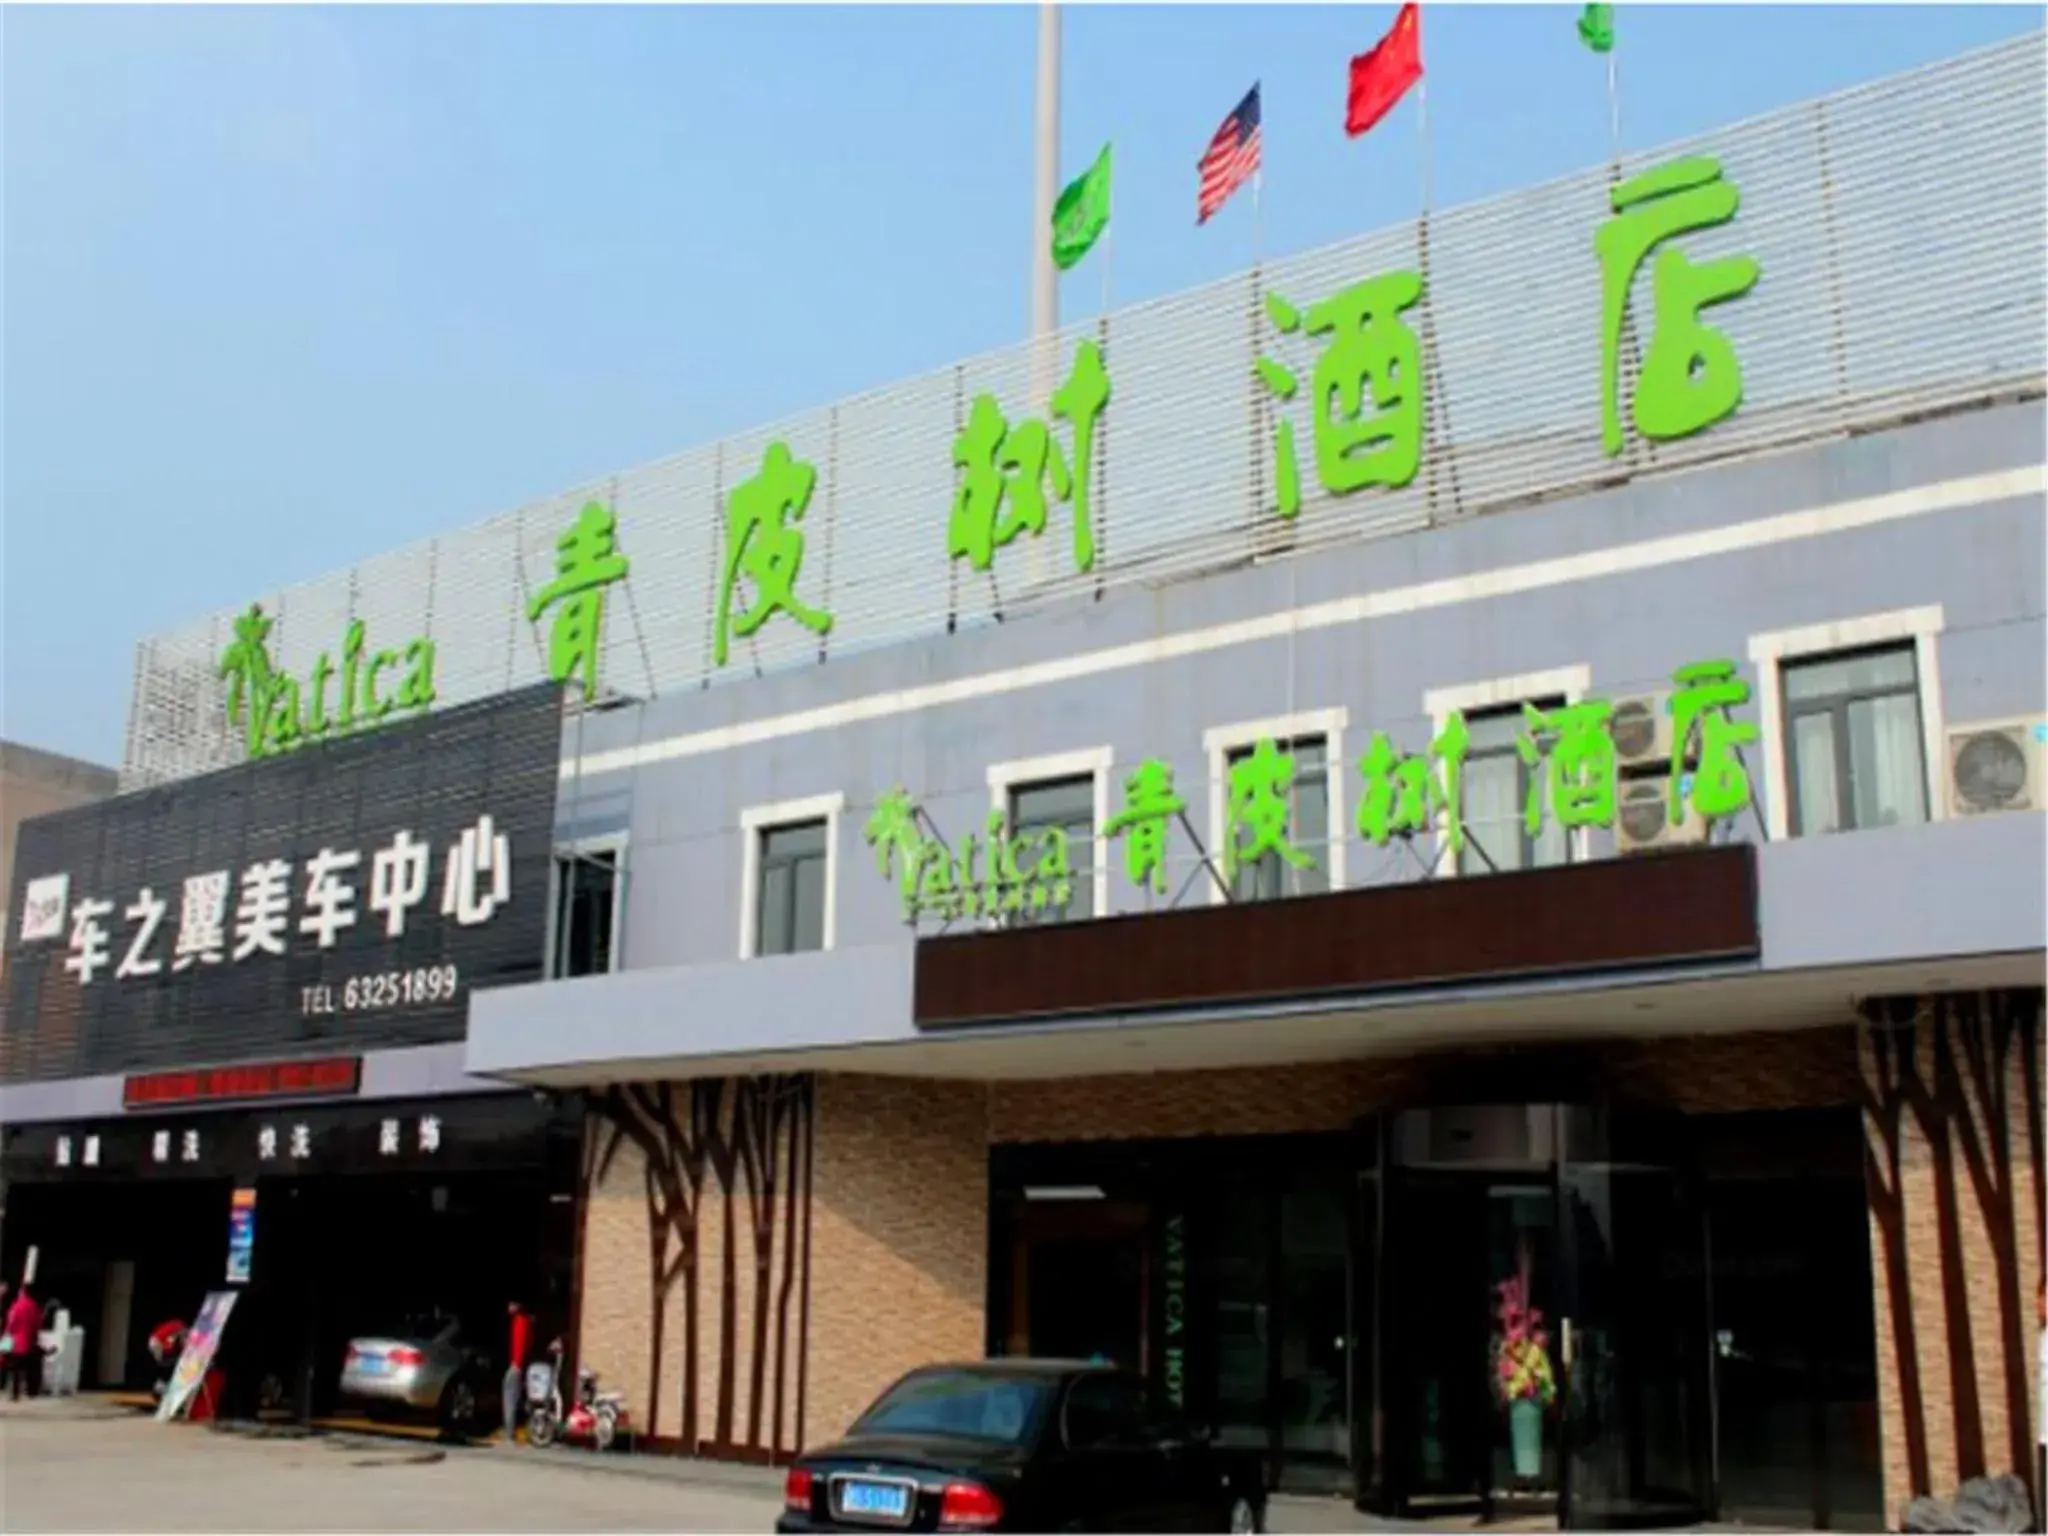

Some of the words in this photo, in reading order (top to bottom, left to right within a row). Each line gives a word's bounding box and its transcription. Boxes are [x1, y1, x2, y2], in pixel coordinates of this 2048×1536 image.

[525, 154, 1763, 704] 青皮树酒店
[1104, 658, 1760, 896] 青皮树酒店
[64, 813, 512, 986] 车之翼美车中心
[302, 985, 334, 1016] TEL
[344, 963, 458, 1010] 63251899
[1165, 1213, 1185, 1336] VATICA
